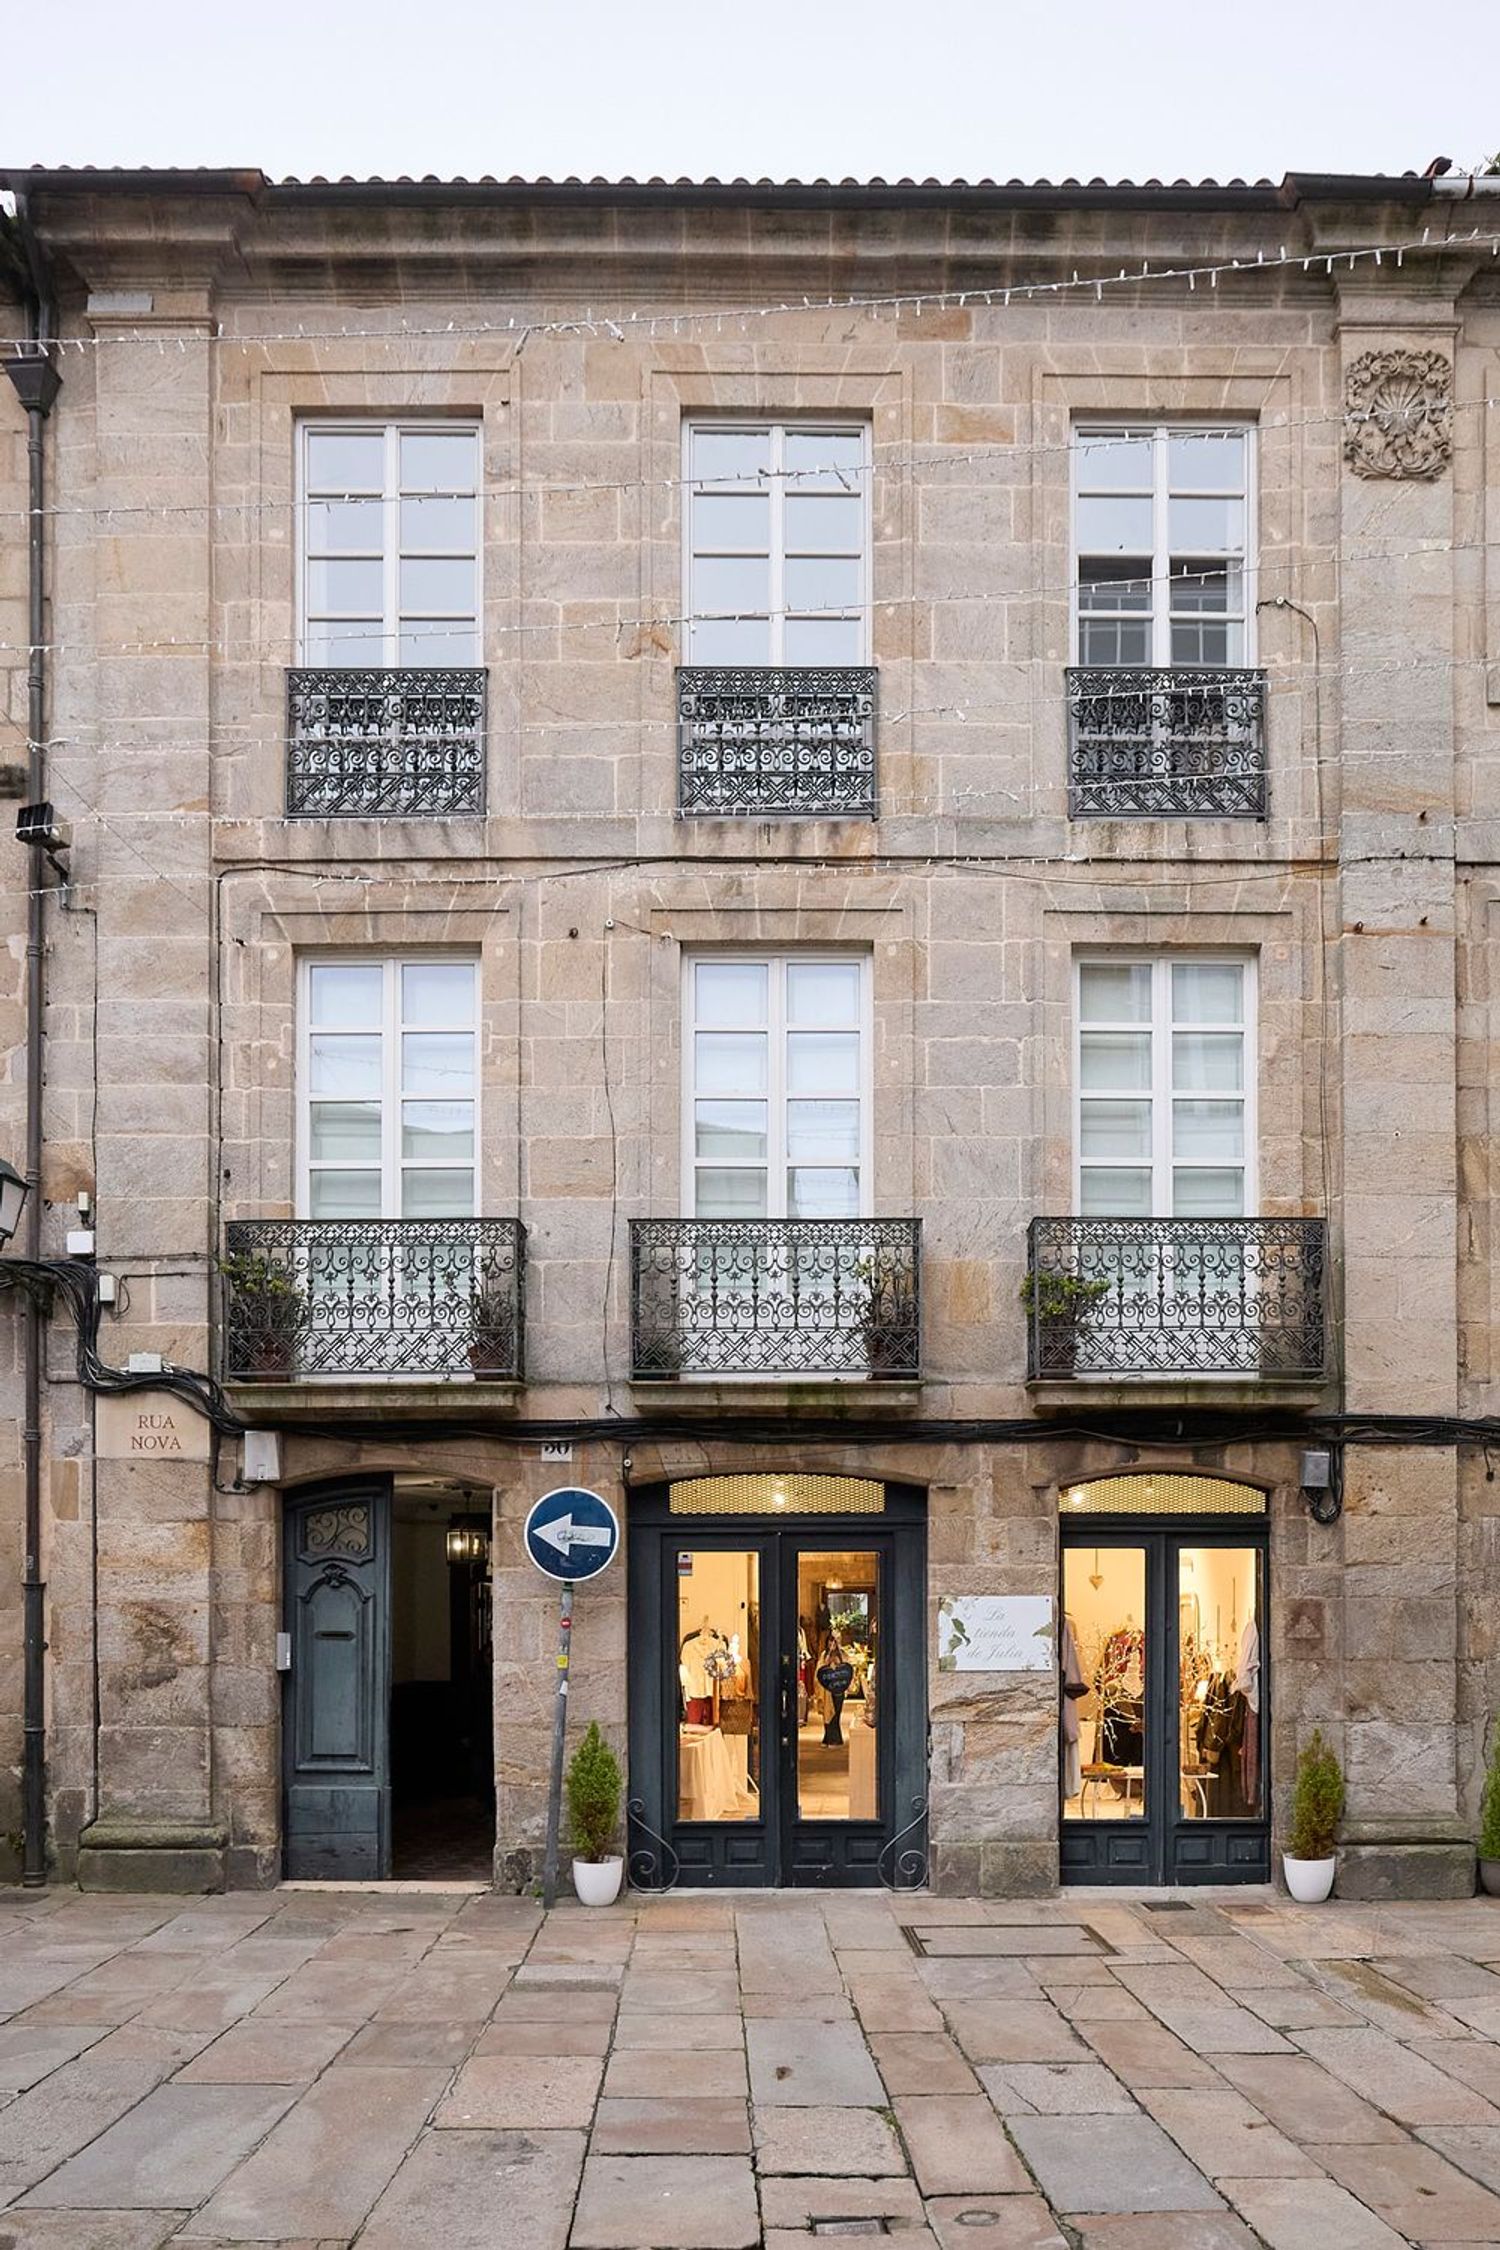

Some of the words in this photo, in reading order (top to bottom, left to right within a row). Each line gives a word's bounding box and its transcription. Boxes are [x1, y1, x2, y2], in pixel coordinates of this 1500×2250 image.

[138, 1414, 175, 1429] RUA
[131, 1435, 181, 1450] NOVA
[973, 1625, 1016, 1638] tienda
[967, 1646, 982, 1657] de
